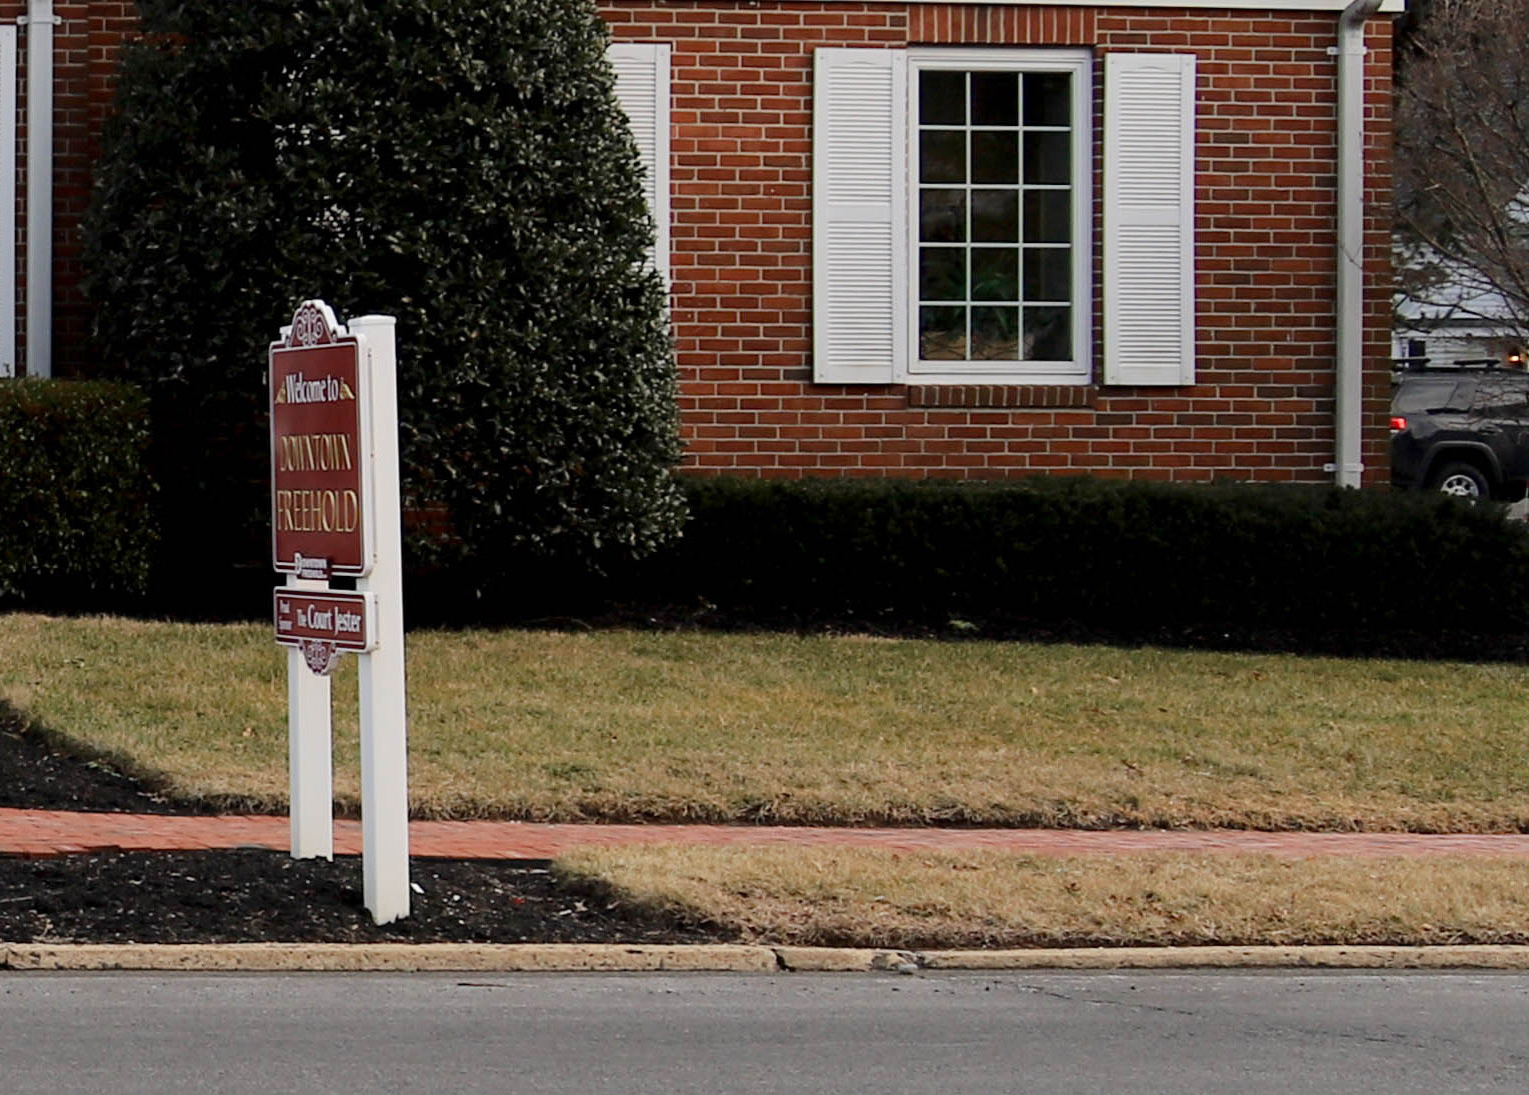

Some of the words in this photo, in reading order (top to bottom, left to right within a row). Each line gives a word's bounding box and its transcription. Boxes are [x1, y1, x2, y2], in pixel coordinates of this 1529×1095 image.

[285, 371, 326, 404] Welcome
[327, 373, 339, 402] to
[280, 434, 352, 472] DOWNTOWN
[277, 490, 358, 533] FREEHOLD
[307, 604, 333, 631] Court
[334, 605, 361, 636] Jester
